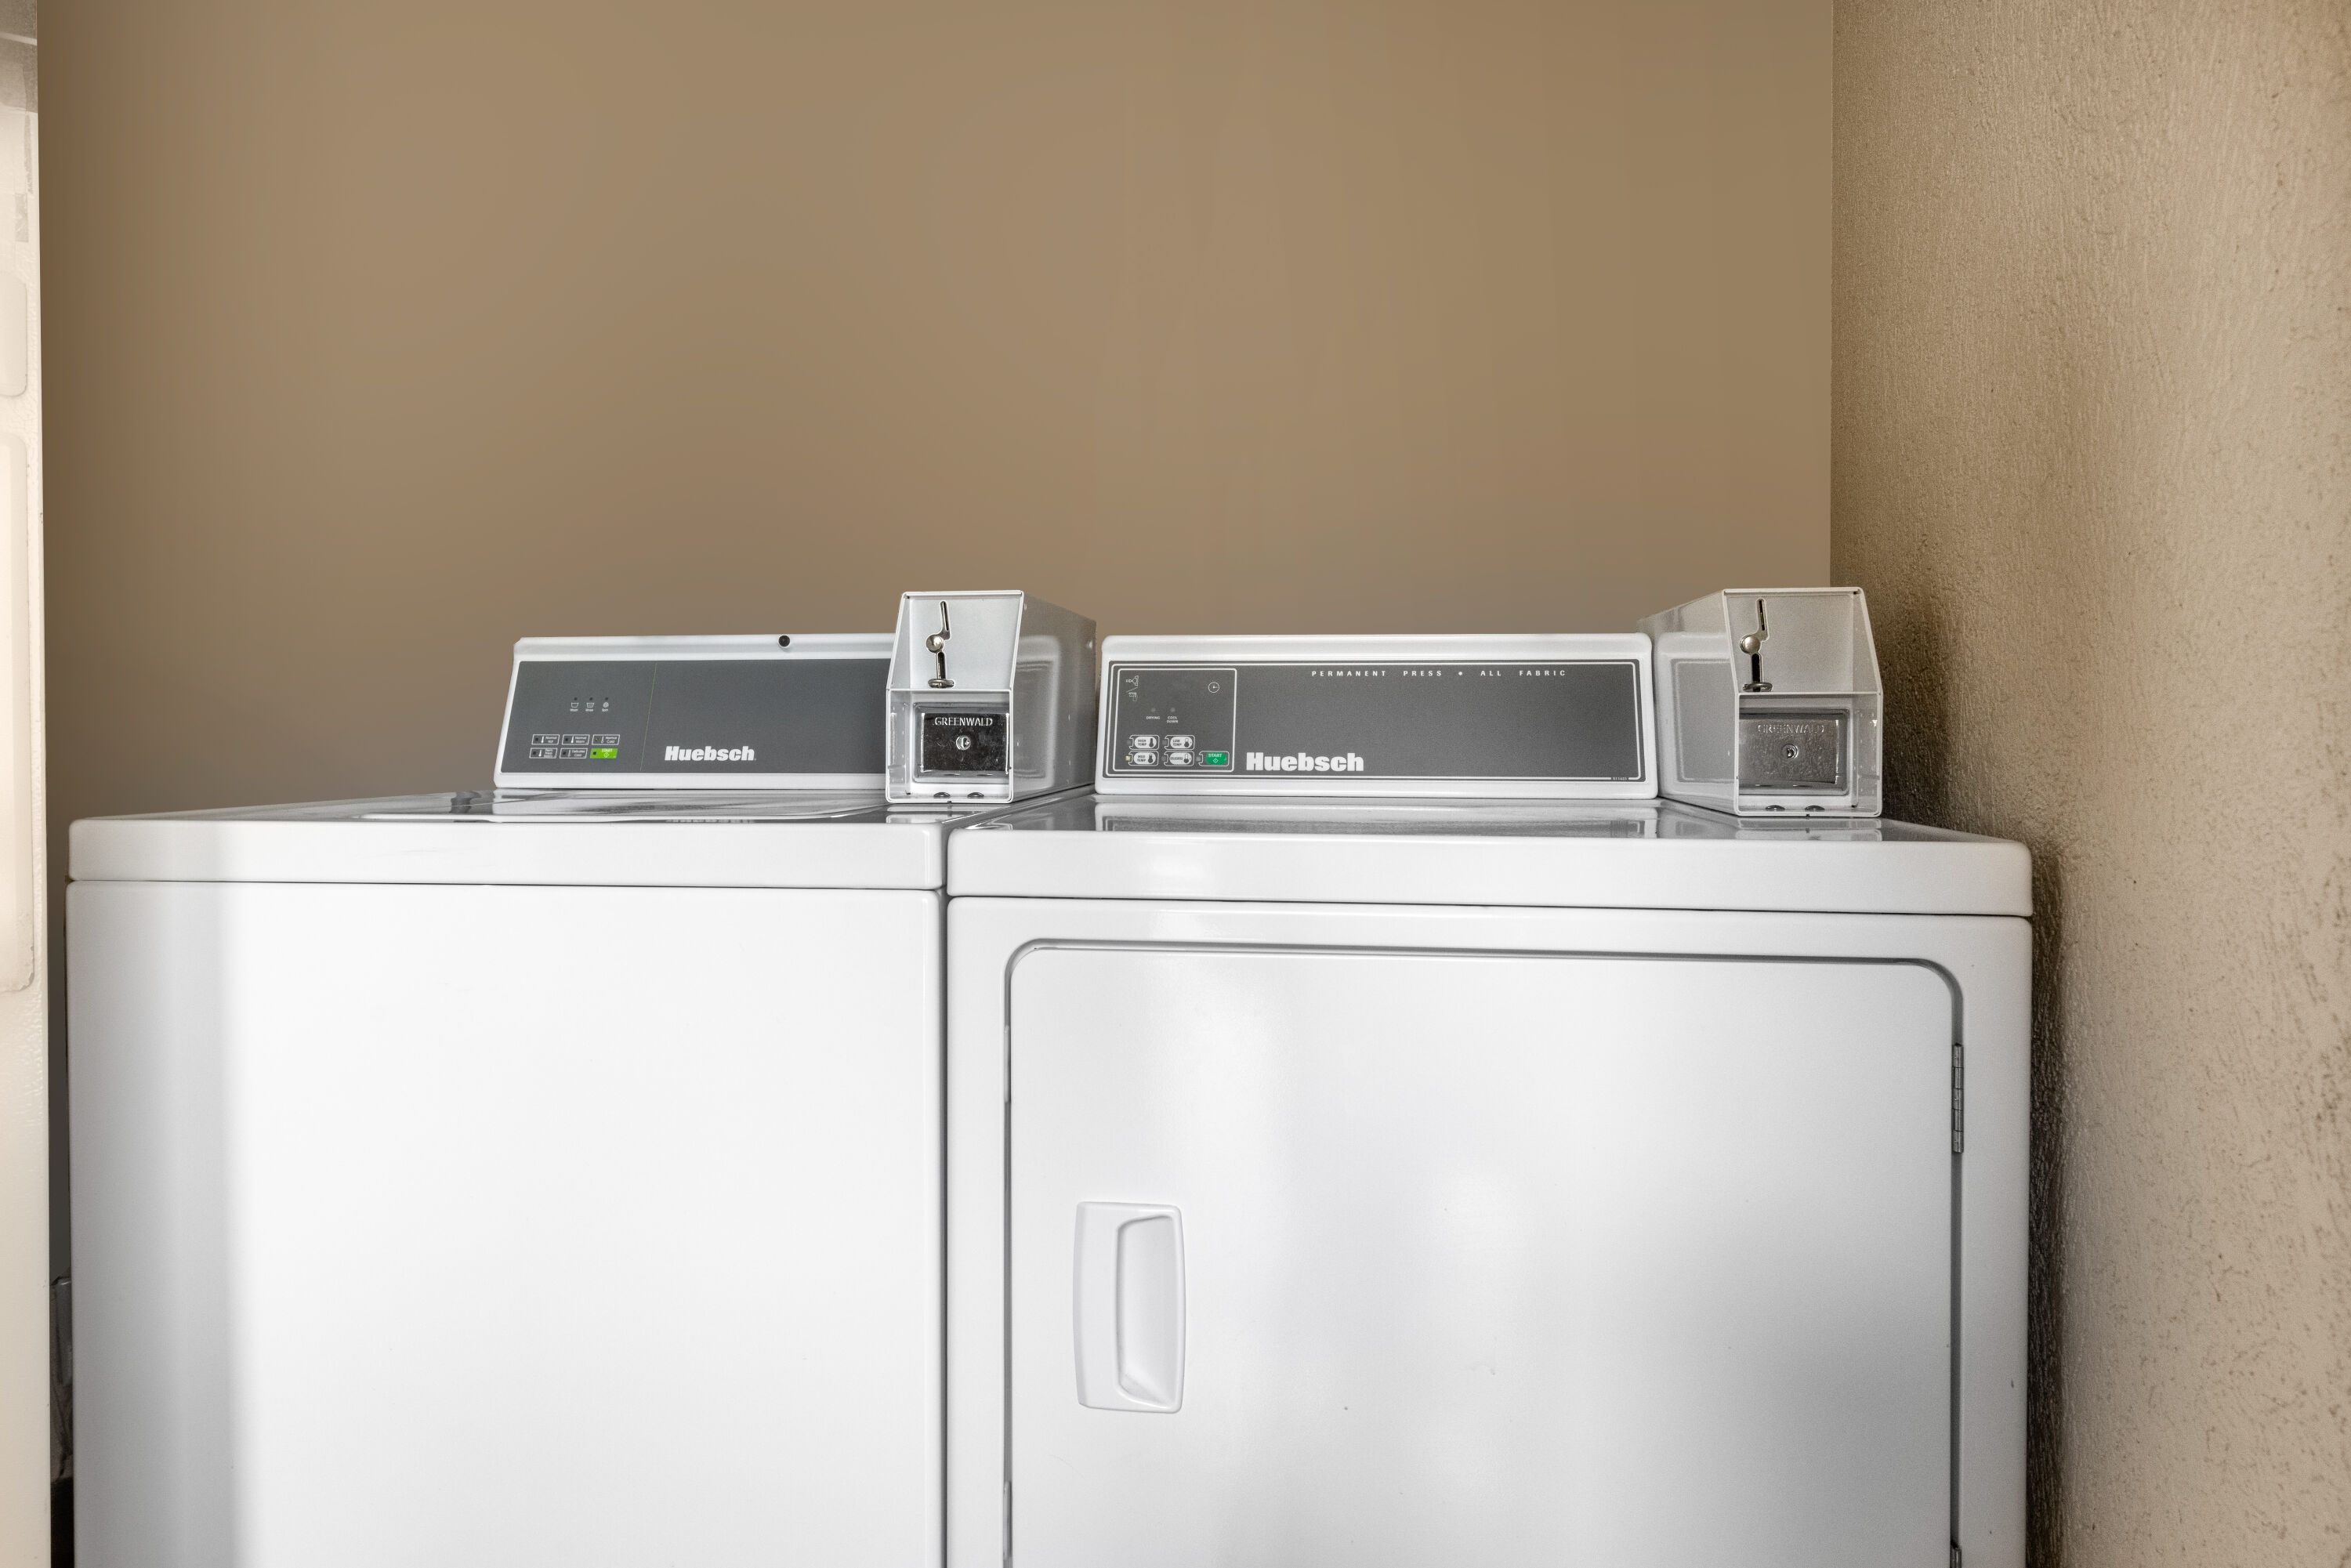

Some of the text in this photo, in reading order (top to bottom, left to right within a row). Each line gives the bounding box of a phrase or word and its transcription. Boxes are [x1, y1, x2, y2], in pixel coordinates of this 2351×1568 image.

[934, 717, 993, 726] GREENWALD
[665, 746, 755, 761] Huebsch
[1246, 751, 1364, 772] Huebsch
